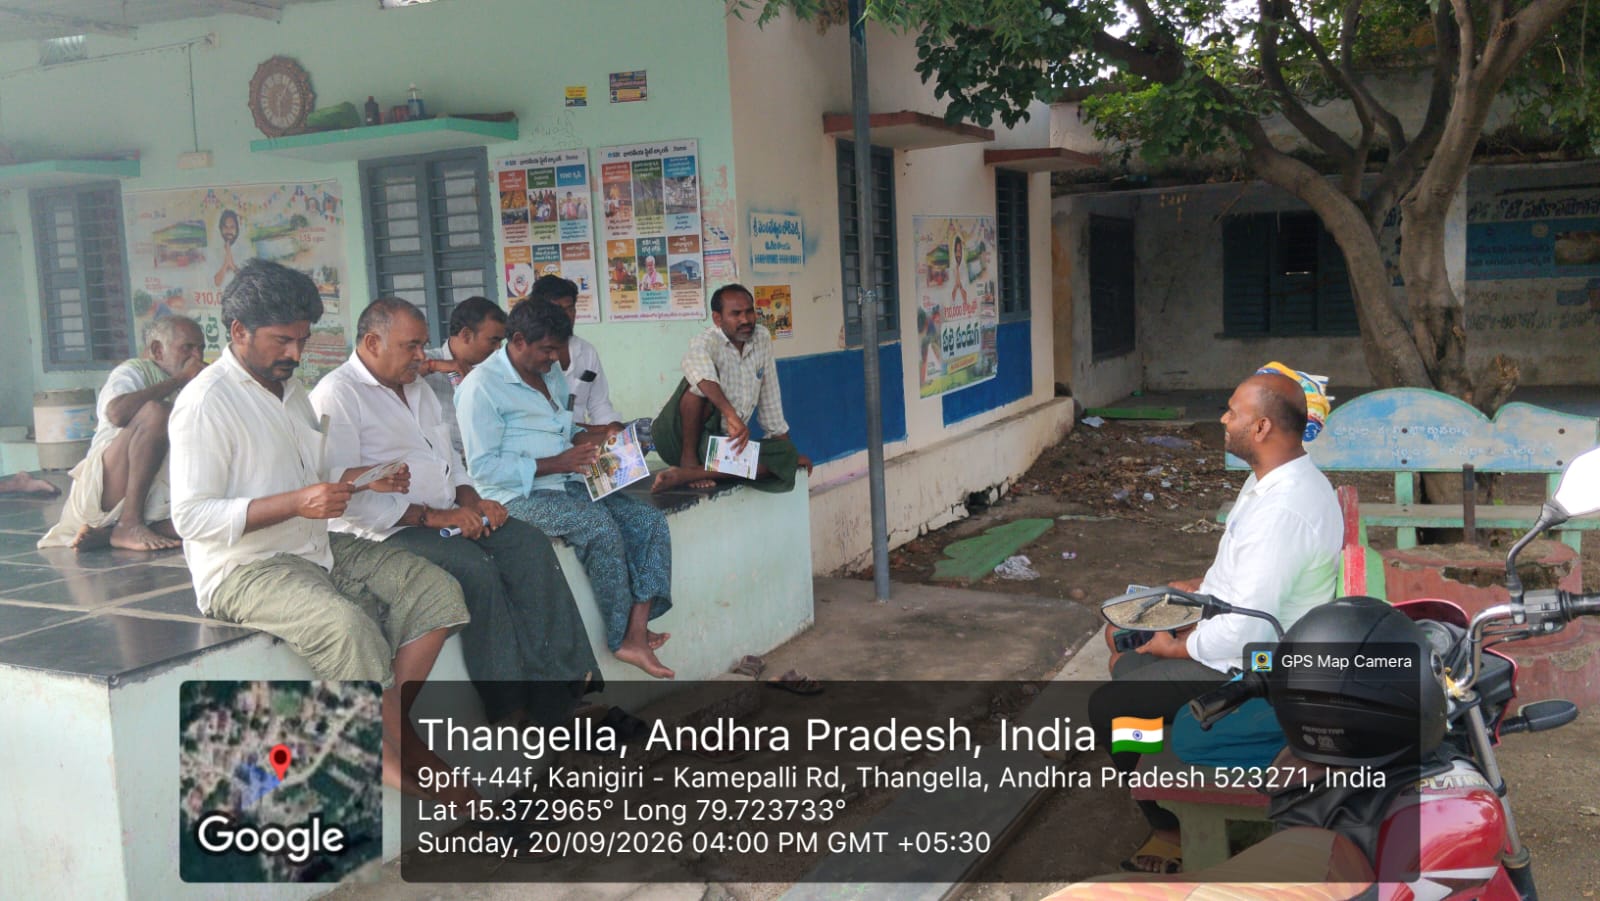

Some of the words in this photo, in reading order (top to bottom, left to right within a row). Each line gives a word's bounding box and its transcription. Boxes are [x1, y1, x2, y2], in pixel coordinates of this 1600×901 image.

[194, 292, 223, 307] ₹10,0
[943, 328, 955, 356] పల్లె
[956, 322, 980, 349] పండుగ
[1419, 775, 1489, 793] PLATIN
